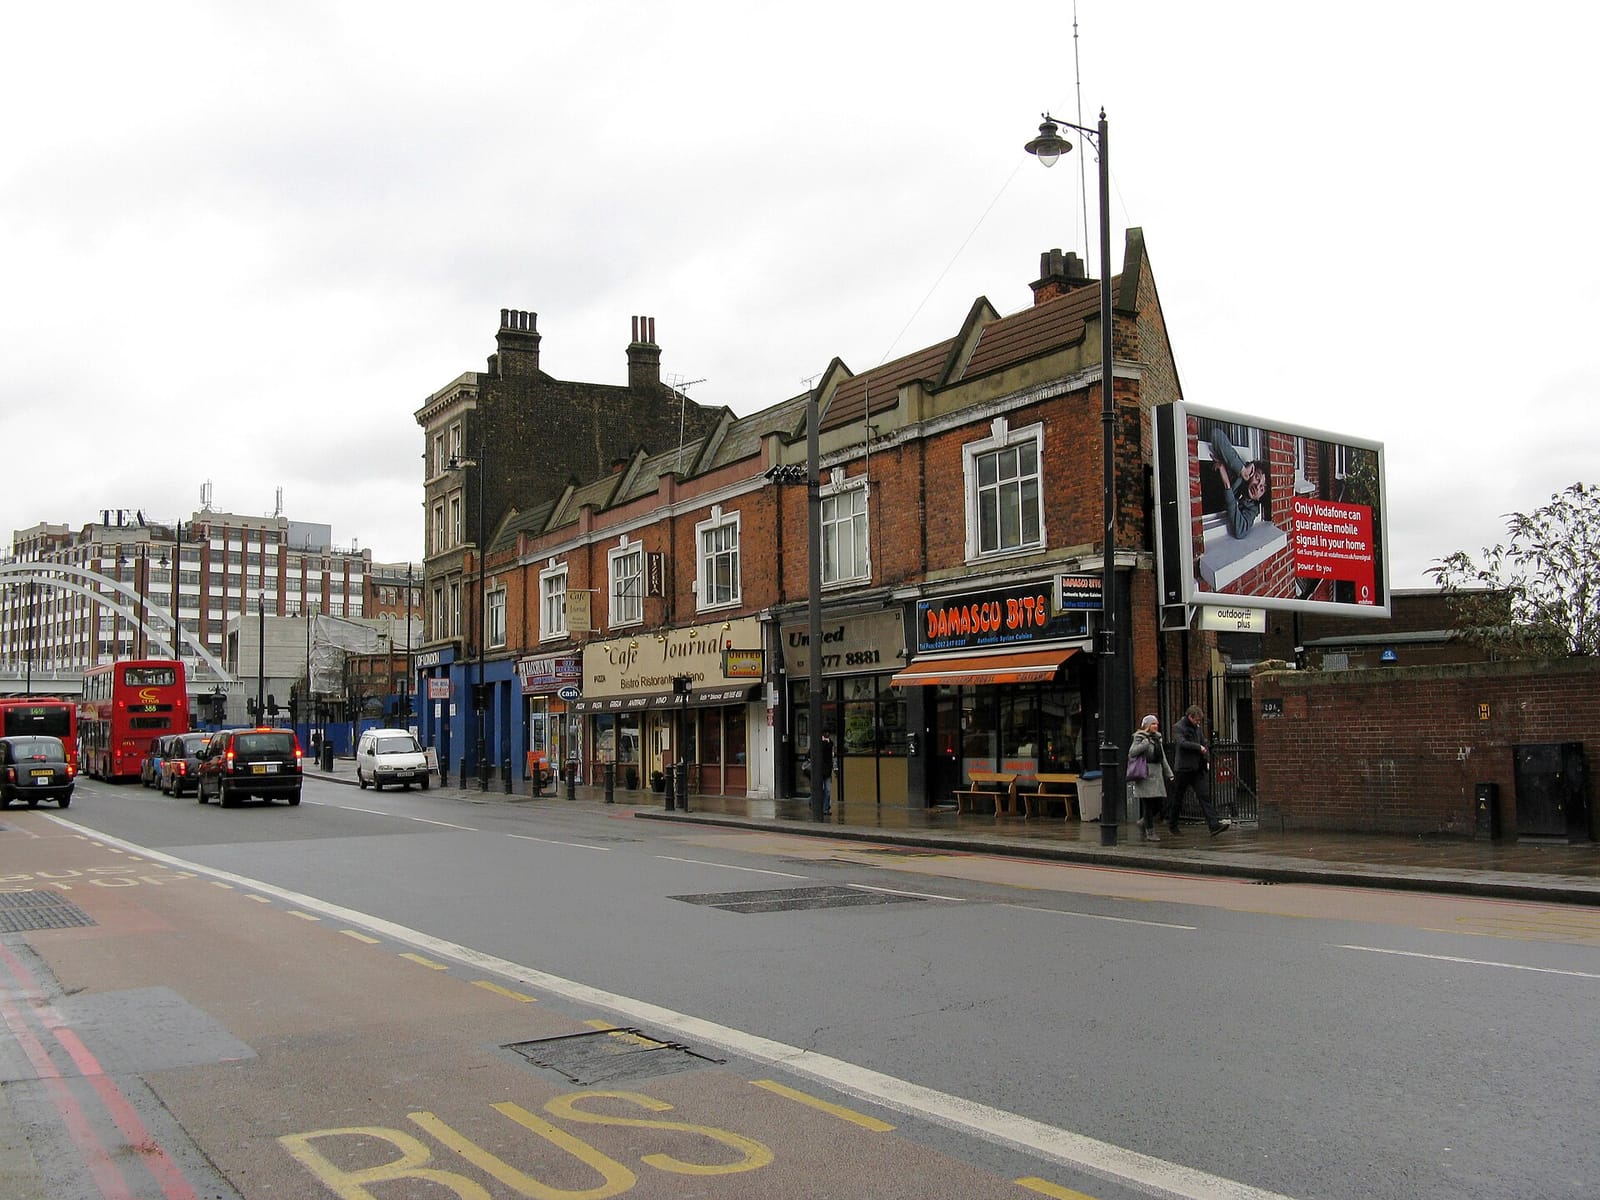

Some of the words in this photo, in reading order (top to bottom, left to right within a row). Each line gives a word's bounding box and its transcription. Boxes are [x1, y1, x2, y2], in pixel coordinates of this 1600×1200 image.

[99, 508, 145, 527] TEA
[1294, 501, 1313, 518] Only
[1313, 504, 1348, 519] Vodafone
[1348, 511, 1361, 521] can
[1295, 520, 1333, 532] guarantee
[1333, 523, 1358, 535] mobile
[1296, 533, 1319, 548] signal
[1319, 535, 1327, 547] in
[1328, 539, 1345, 550] your
[1345, 538, 1366, 551] home
[650, 554, 660, 594] PIZZERIA
[1296, 562, 1314, 571] power
[1315, 563, 1322, 571] to
[1322, 565, 1332, 574] you
[927, 601, 1001, 638] DAMASCU
[1217, 609, 1244, 619] outdoor
[1237, 620, 1251, 629] plus
[788, 626, 845, 648] Uned
[662, 631, 724, 664] Journal
[729, 651, 760, 659] UNITED
[424, 652, 439, 666] LONDON
[845, 649, 880, 666] 8881
[640, 673, 675, 688] Ristorante
[278, 1091, 774, 1200] BUS
